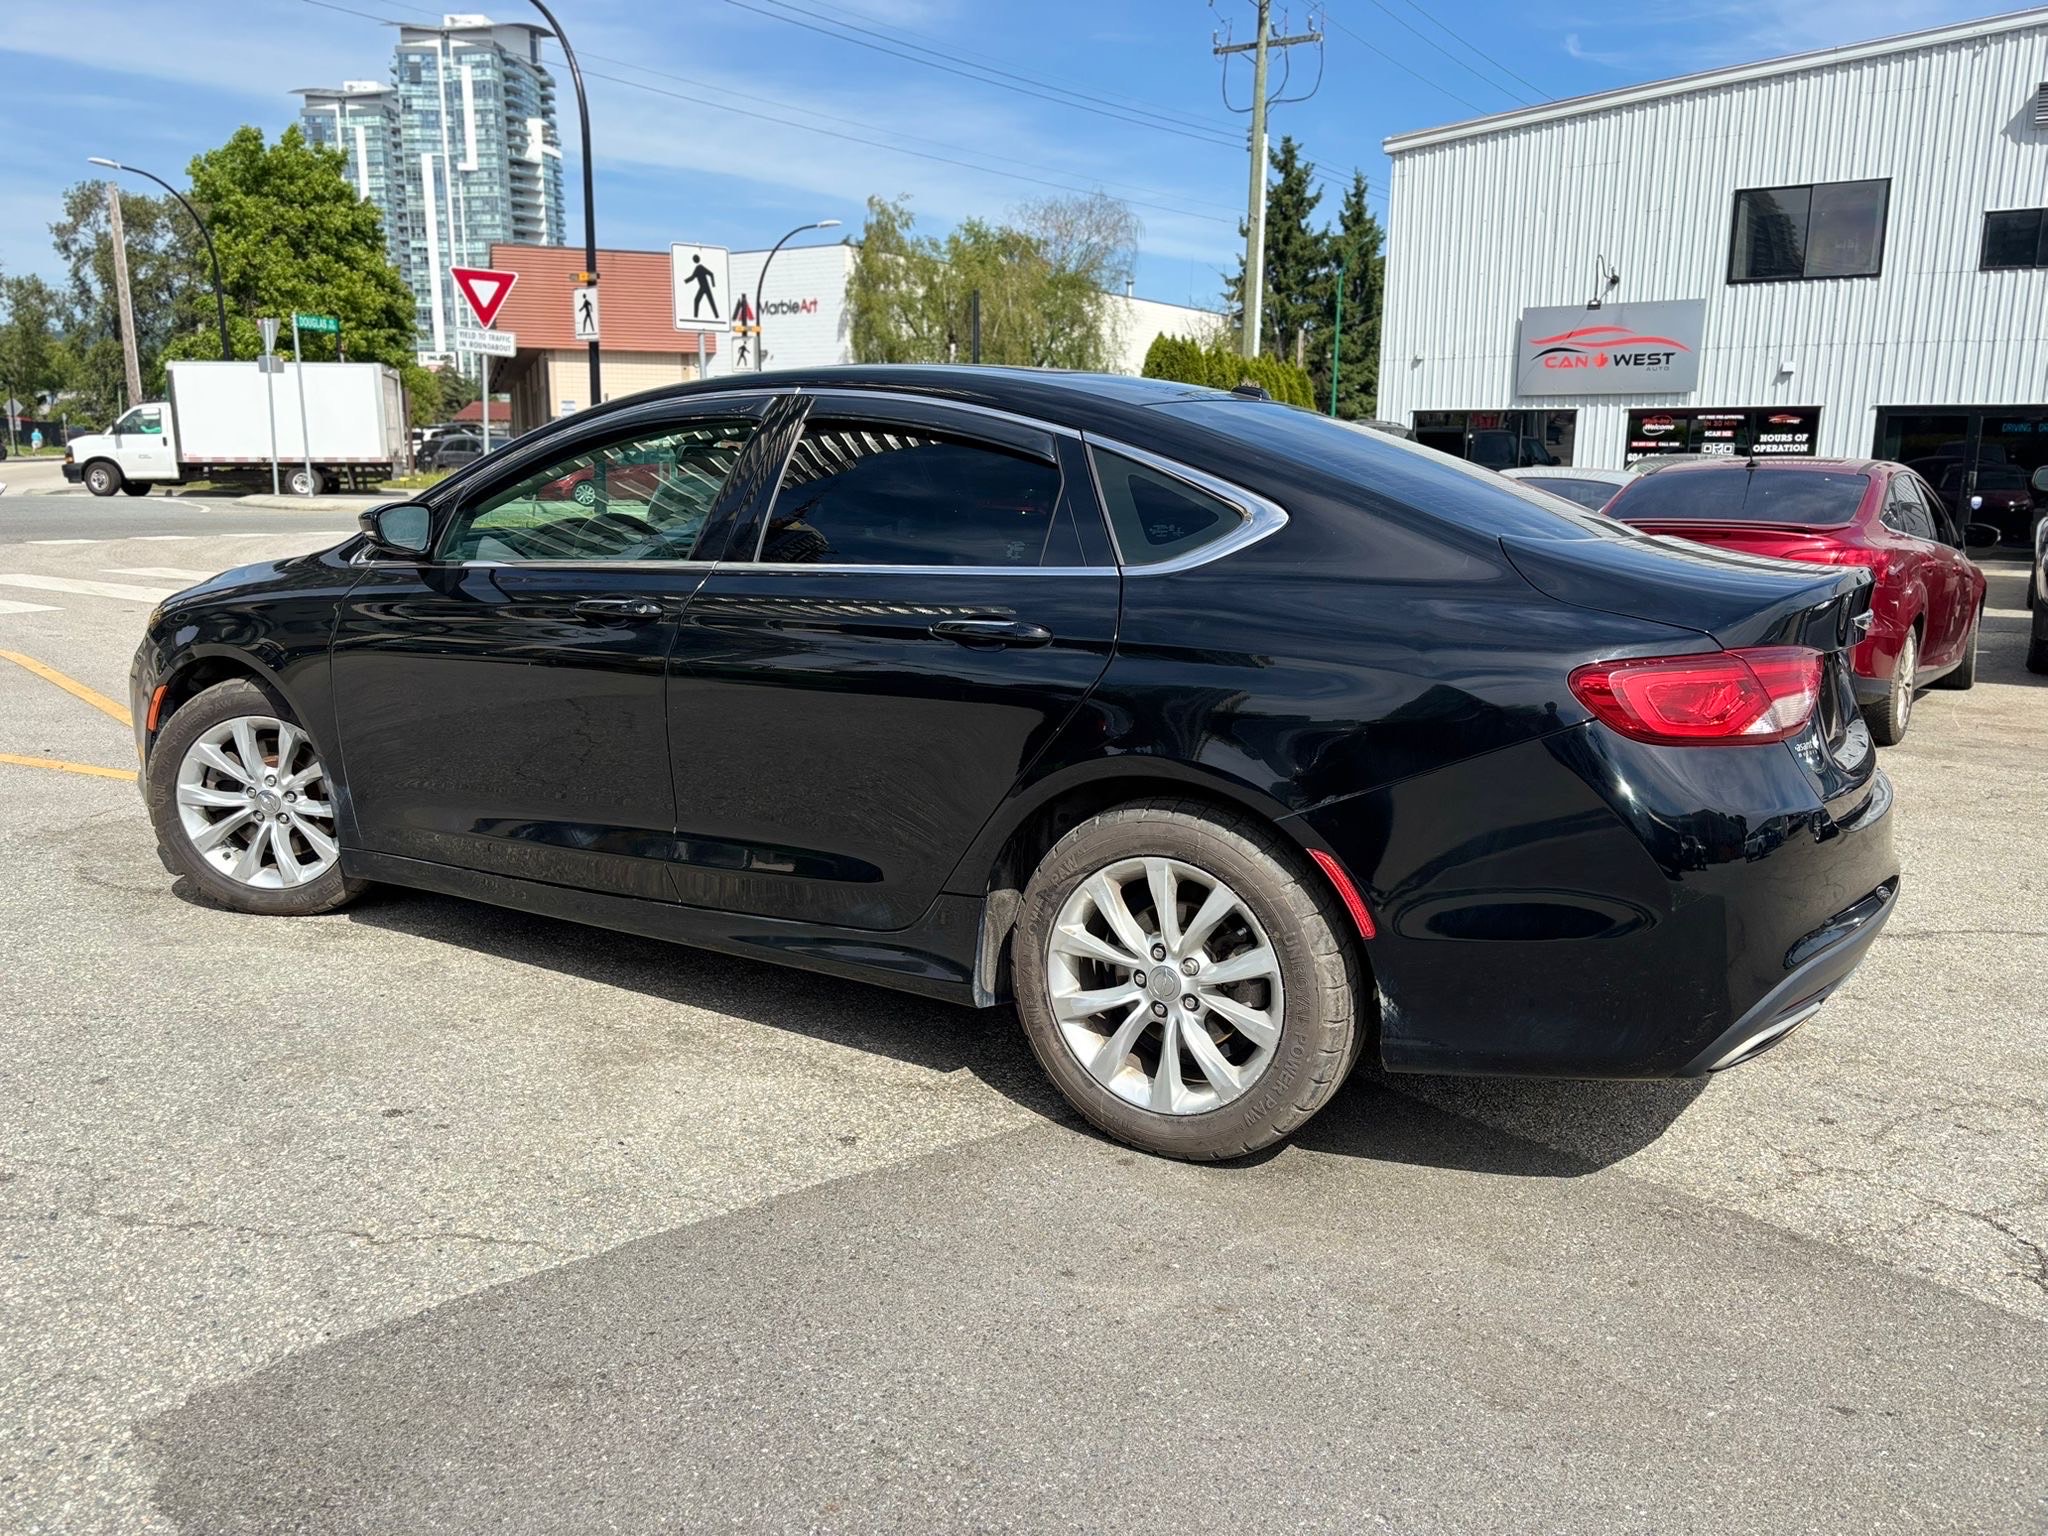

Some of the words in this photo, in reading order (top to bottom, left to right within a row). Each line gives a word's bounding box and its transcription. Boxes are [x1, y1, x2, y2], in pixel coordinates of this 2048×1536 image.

[299, 316, 327, 329] DOUGLAS
[459, 331, 476, 339] YIELD
[489, 334, 512, 343] TRAFFIC
[469, 342, 511, 352] ROUNDABOUT
[1544, 355, 1589, 369] CAN
[1613, 352, 1676, 367] WEST
[1704, 430, 1721, 438] SCAN
[1760, 434, 1793, 442] HOURS
[1794, 434, 1809, 442] OF
[1752, 444, 1809, 453] OPERATION
[1052, 853, 1081, 888] PAW
[1282, 931, 1312, 1024] UNIROYAL
[1270, 1033, 1307, 1093] POWER
[1242, 1095, 1278, 1128] PAW
